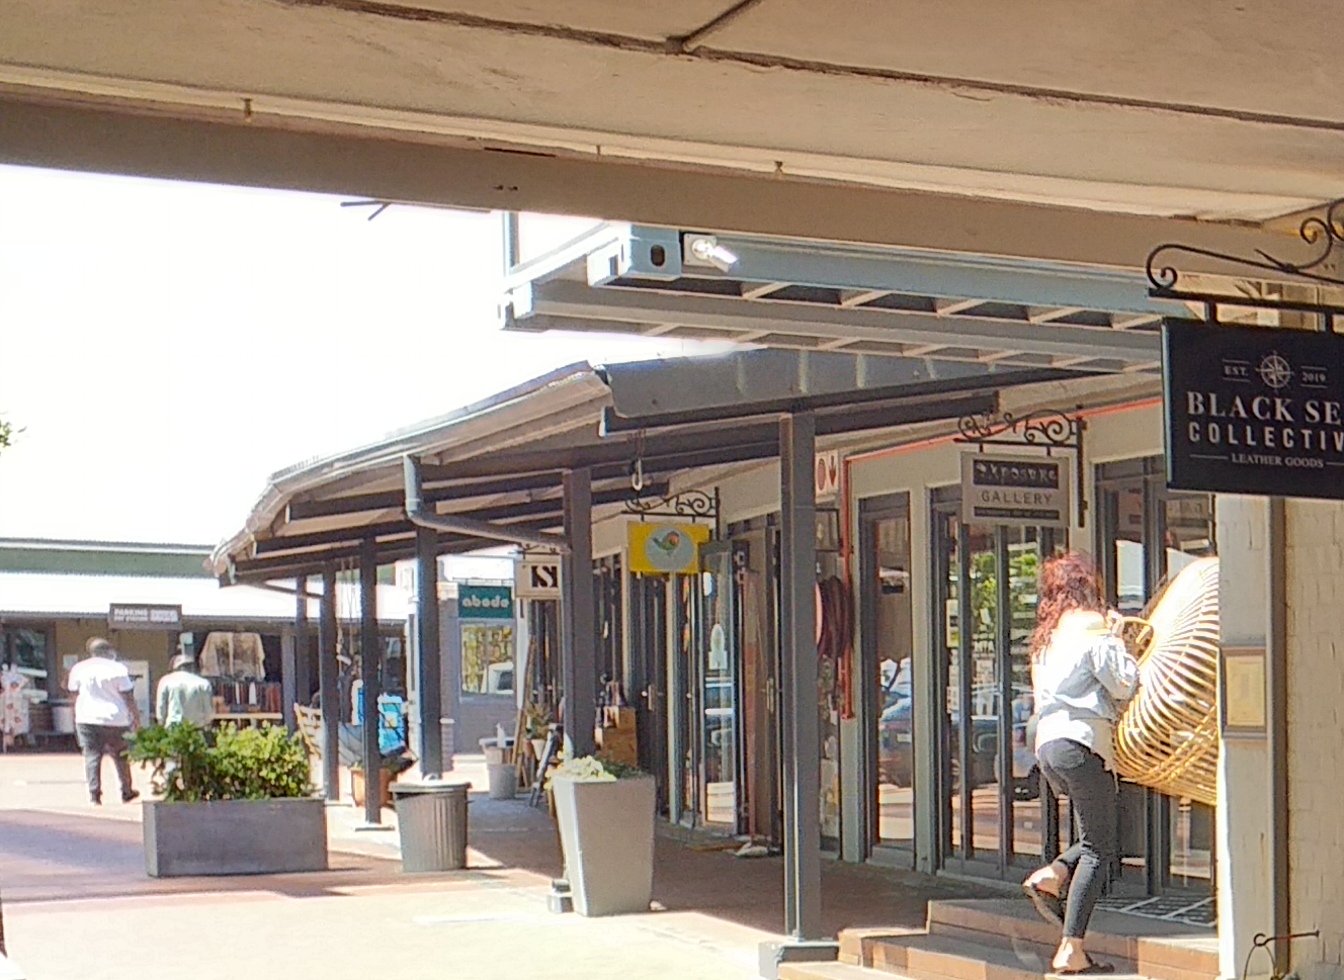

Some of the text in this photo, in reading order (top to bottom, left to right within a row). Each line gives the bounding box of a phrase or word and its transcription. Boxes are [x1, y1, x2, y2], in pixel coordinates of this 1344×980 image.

[1224, 365, 1326, 384] EST. 2019
[1186, 390, 1295, 423] BLACK
[1231, 452, 1325, 469] LEATHER GOODS
[981, 489, 1054, 505] GALLERY
[462, 594, 510, 608] abode
